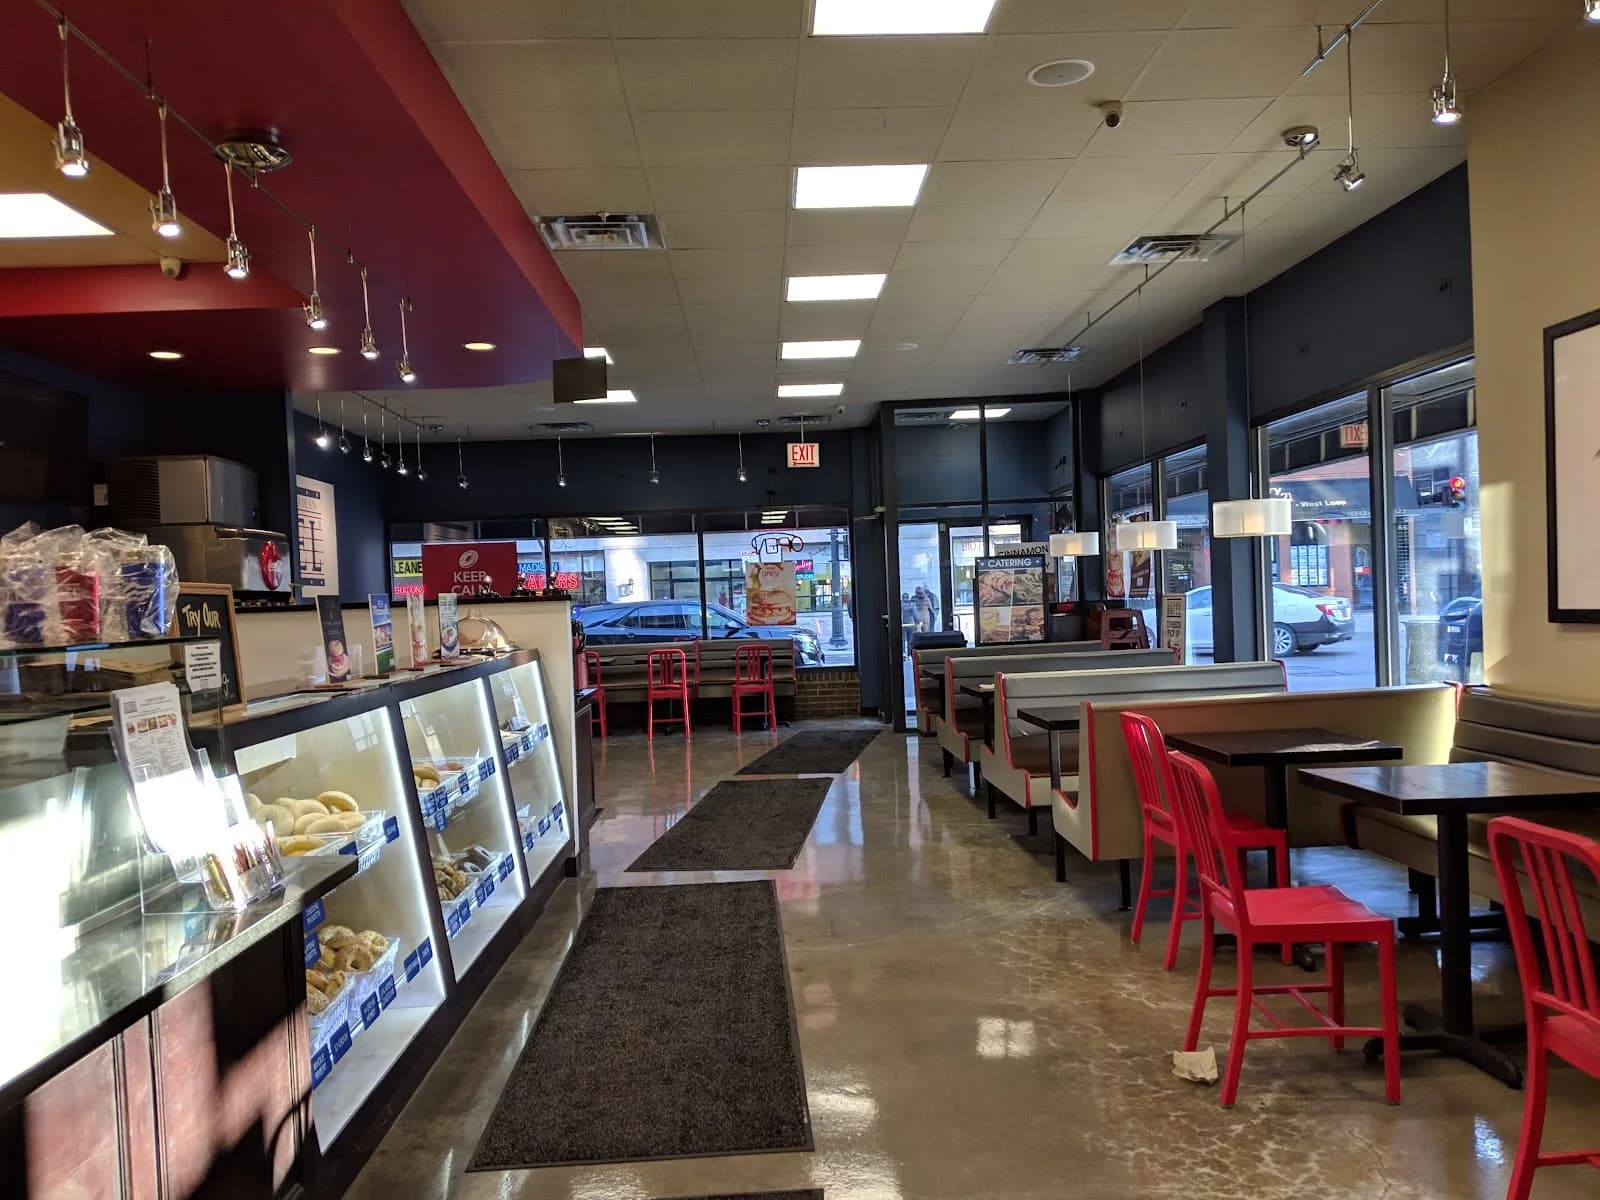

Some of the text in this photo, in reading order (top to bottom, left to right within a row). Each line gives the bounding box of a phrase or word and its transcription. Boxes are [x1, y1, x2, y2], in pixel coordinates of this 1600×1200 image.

[791, 444, 816, 461] EXIT
[394, 560, 423, 574] LEANE
[518, 562, 559, 572] MADISN
[987, 558, 1032, 568] CATERING
[453, 570, 487, 583] KEEP
